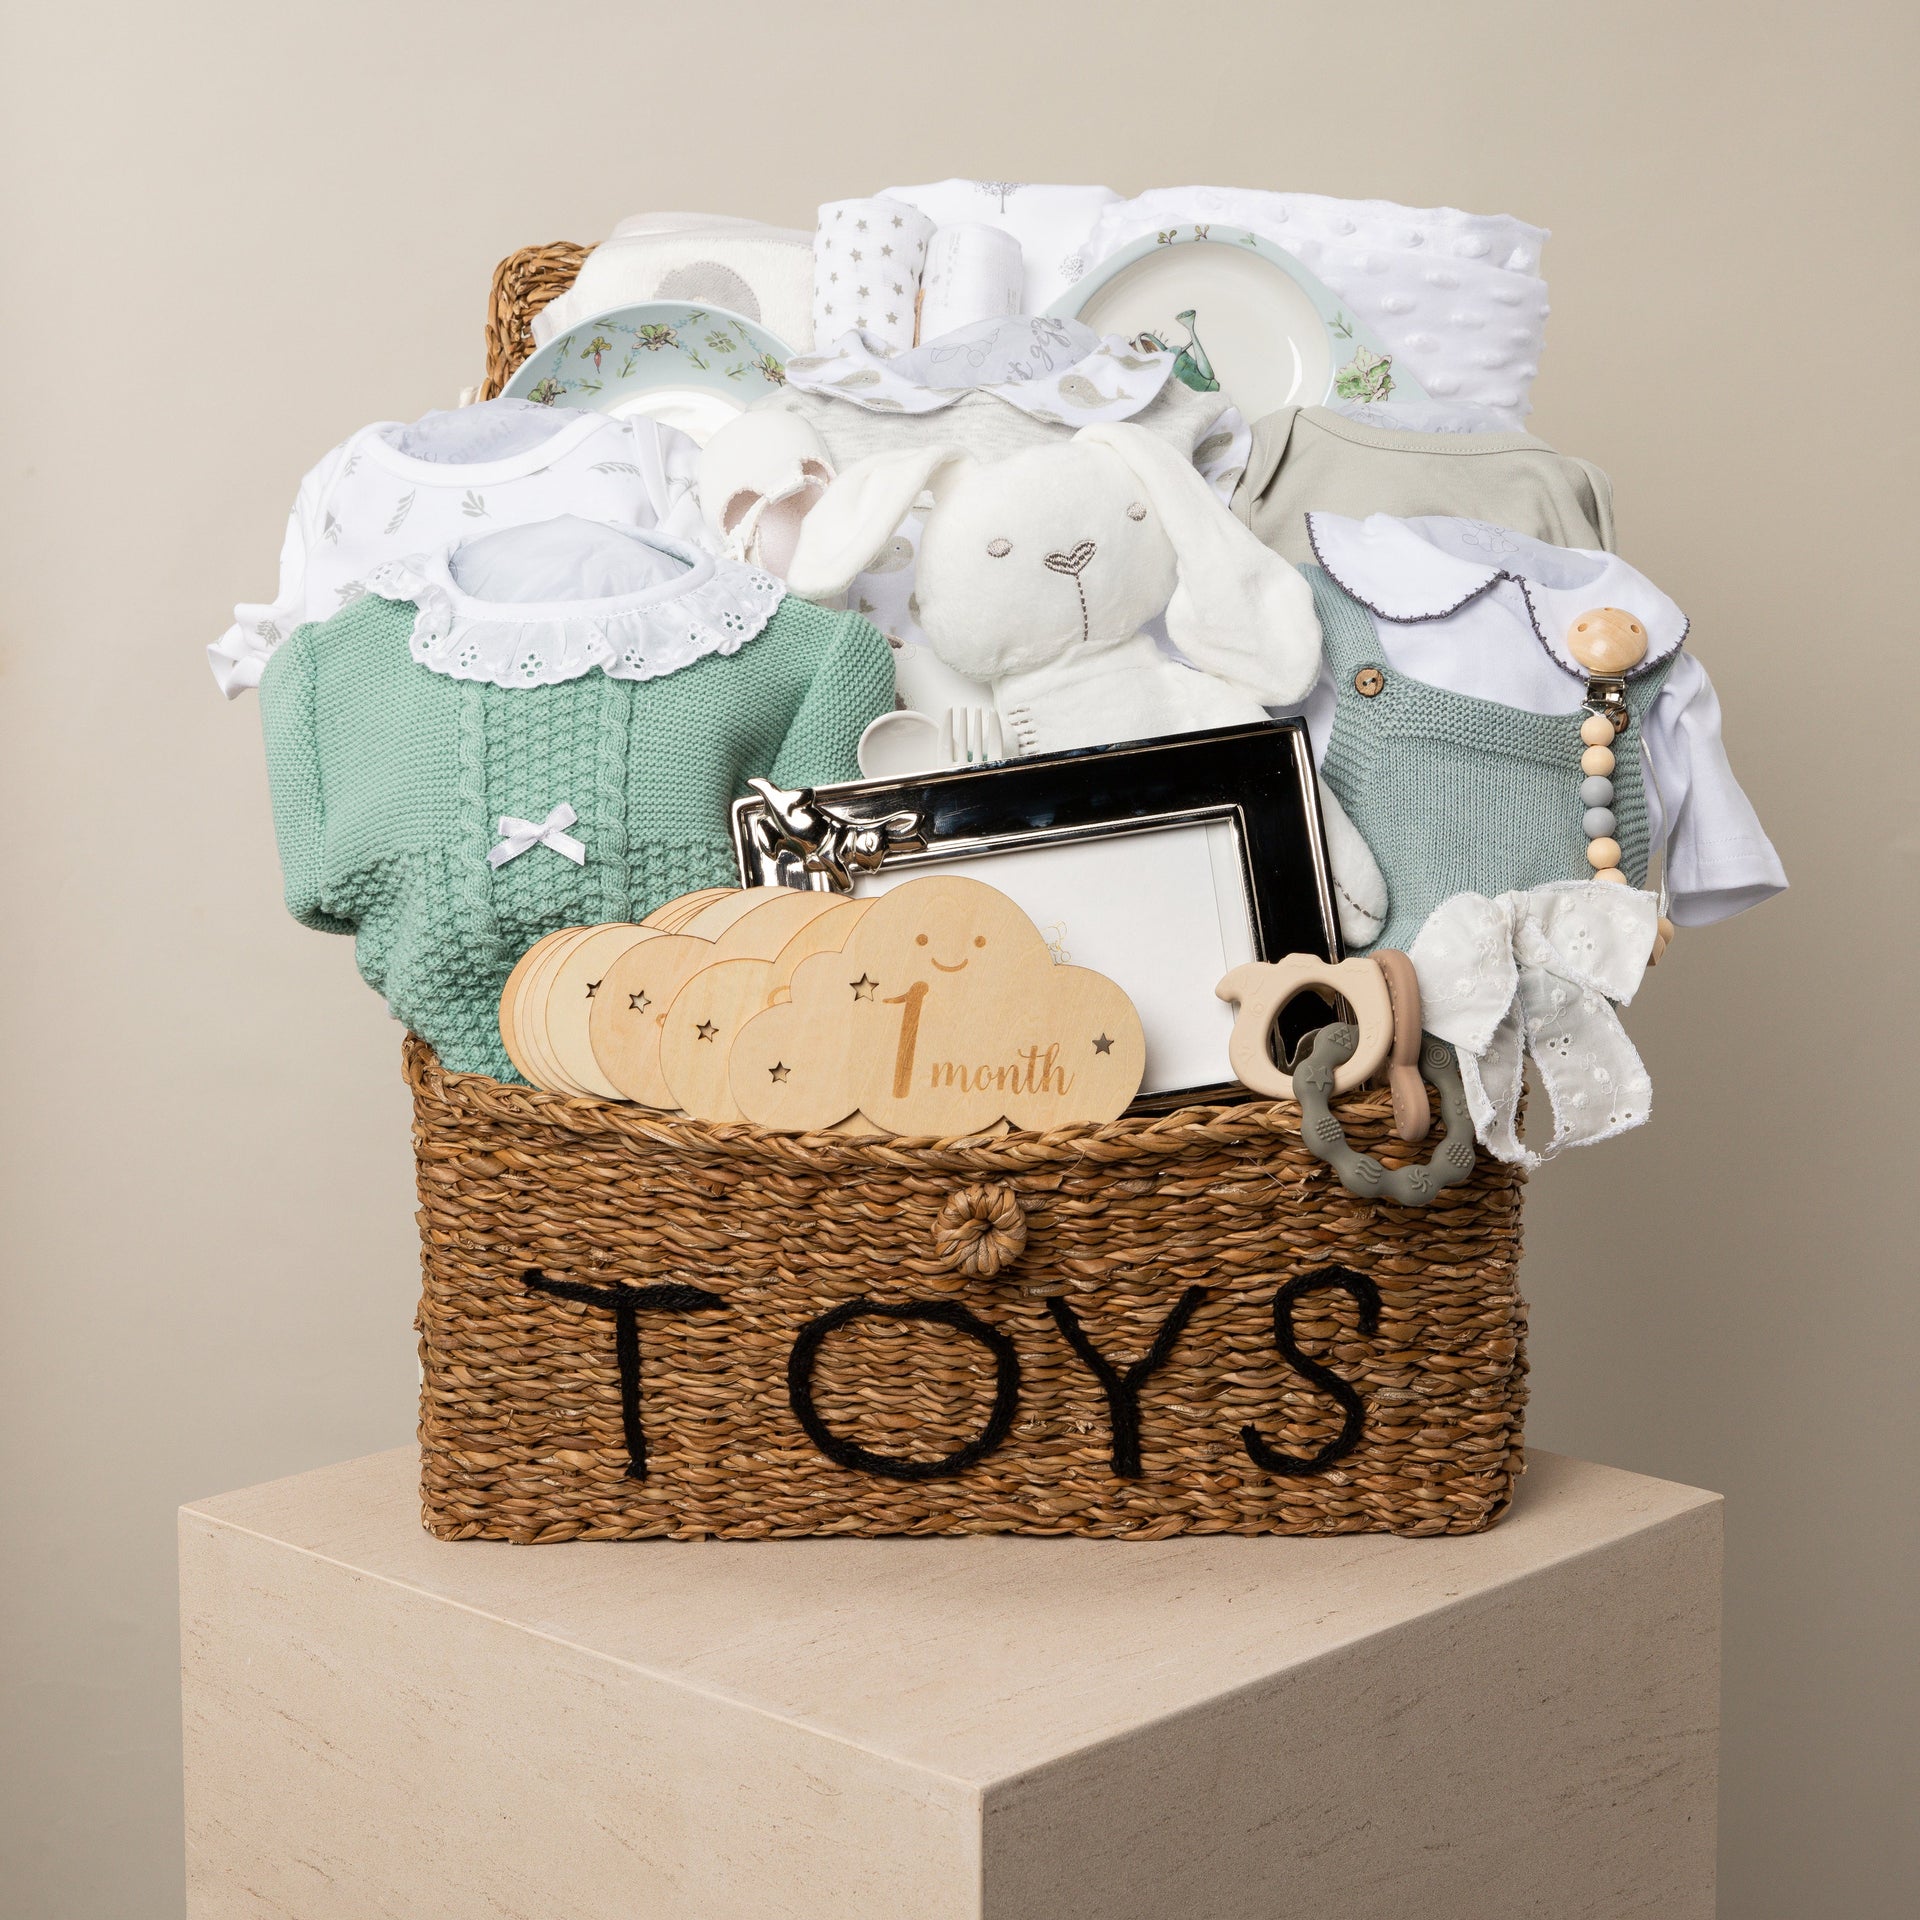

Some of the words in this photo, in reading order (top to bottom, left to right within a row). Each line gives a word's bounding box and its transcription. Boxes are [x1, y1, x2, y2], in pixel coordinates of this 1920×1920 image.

[882, 981, 929, 1099] 1
[931, 1042, 1075, 1096] month
[521, 1264, 1382, 1481] TOYS
